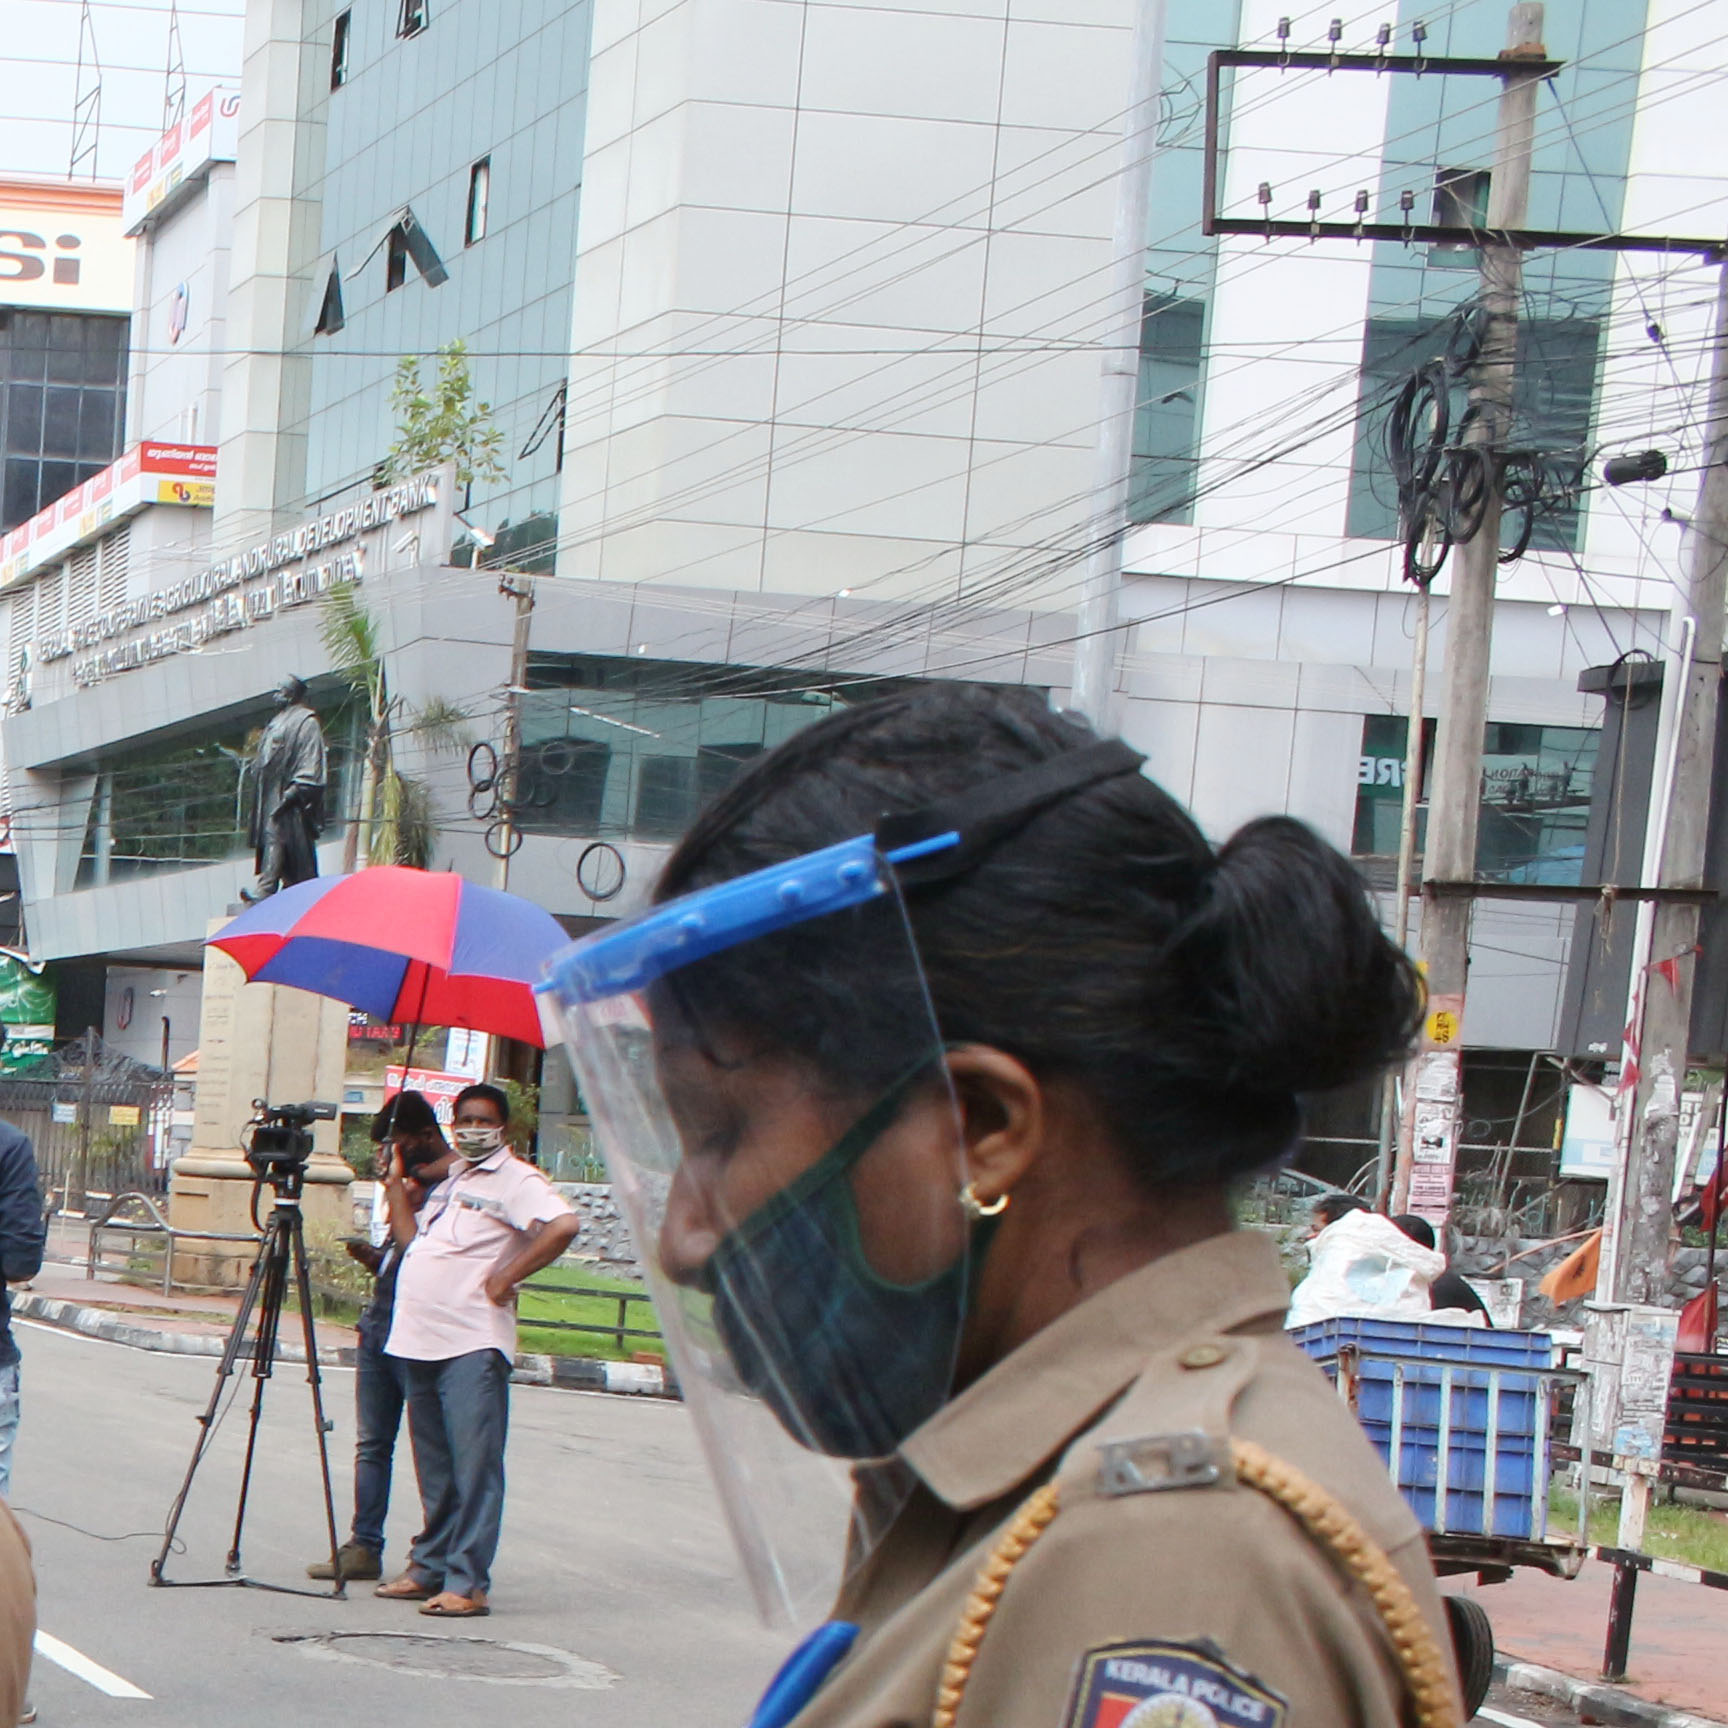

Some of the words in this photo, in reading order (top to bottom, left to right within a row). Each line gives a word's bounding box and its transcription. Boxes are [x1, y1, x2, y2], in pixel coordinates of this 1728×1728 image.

[296, 492, 390, 557] DEVELOPMENT
[390, 475, 430, 518] BANK
[1104, 1658, 1190, 1694] KERALA
[1192, 1677, 1266, 1722] POLICE
